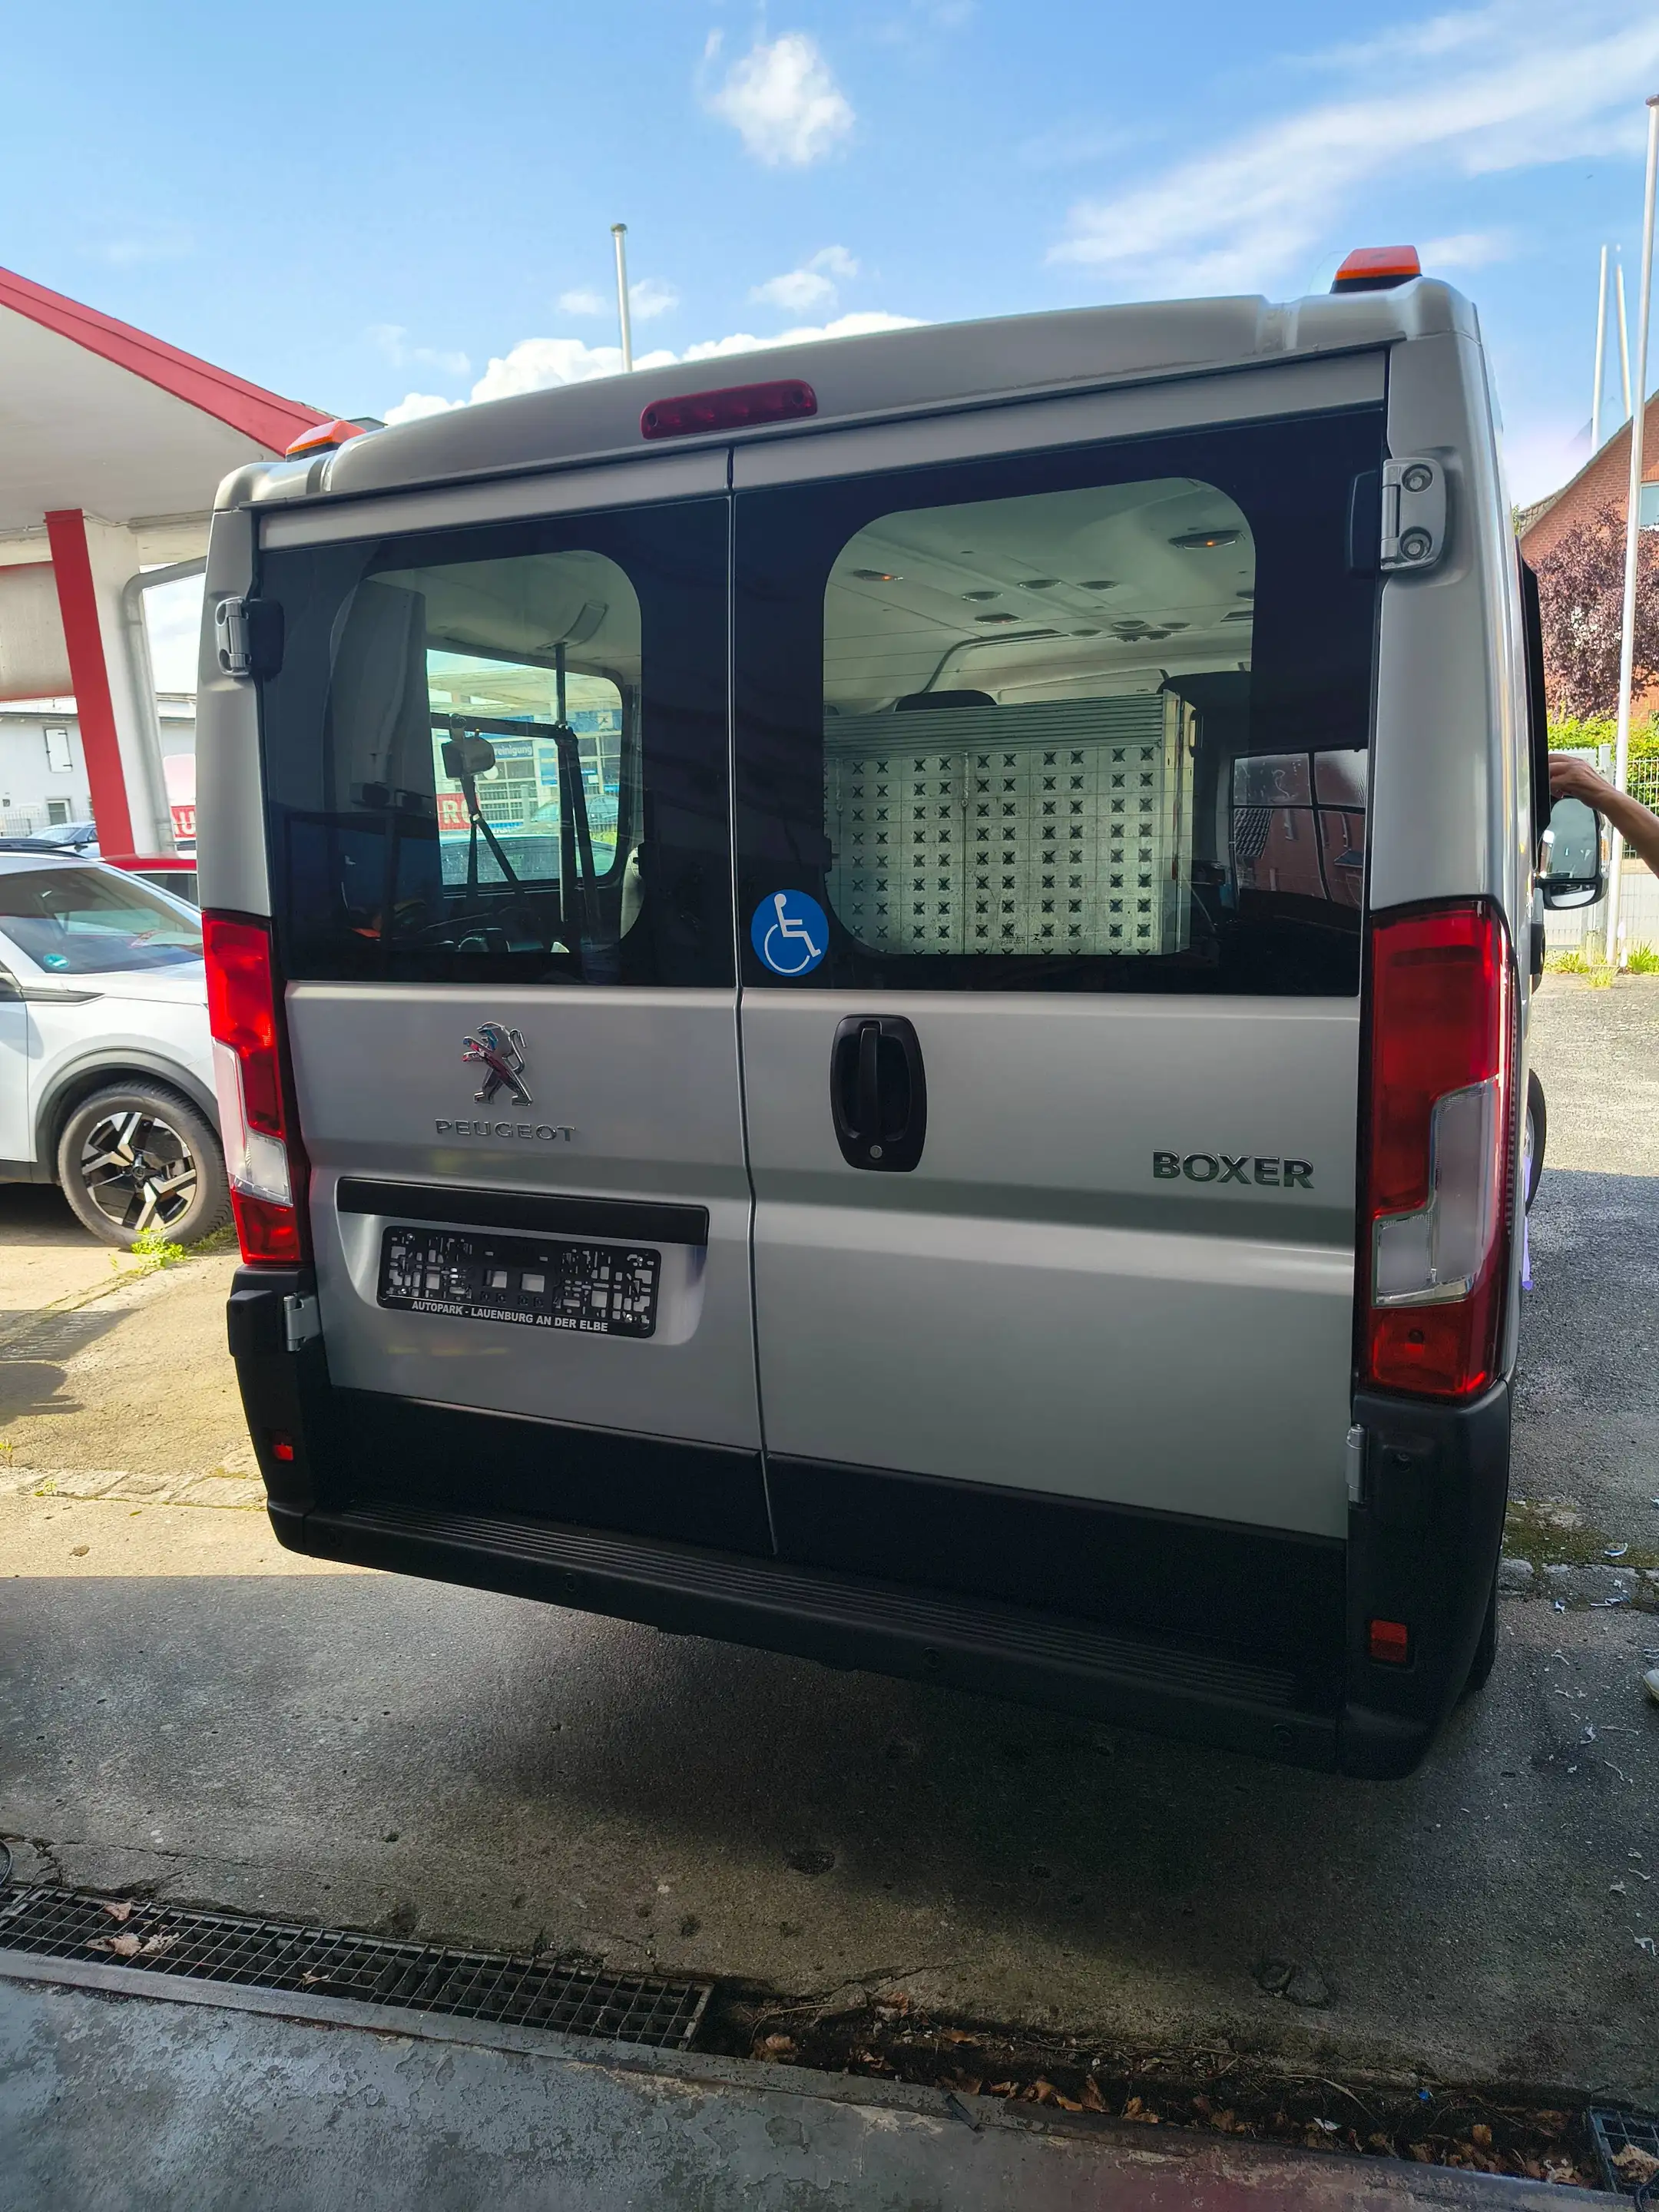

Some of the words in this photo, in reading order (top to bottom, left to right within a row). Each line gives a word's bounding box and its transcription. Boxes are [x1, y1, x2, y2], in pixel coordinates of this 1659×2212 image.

[434, 1118, 576, 1142] PEUGEOT
[1152, 1149, 1314, 1189] BOXER
[412, 1300, 464, 1315] AUTOPARK
[471, 1307, 534, 1323] LAUENBURG
[536, 1315, 551, 1326] AN
[555, 1317, 577, 1329] DER
[579, 1320, 608, 1332] ELBE
